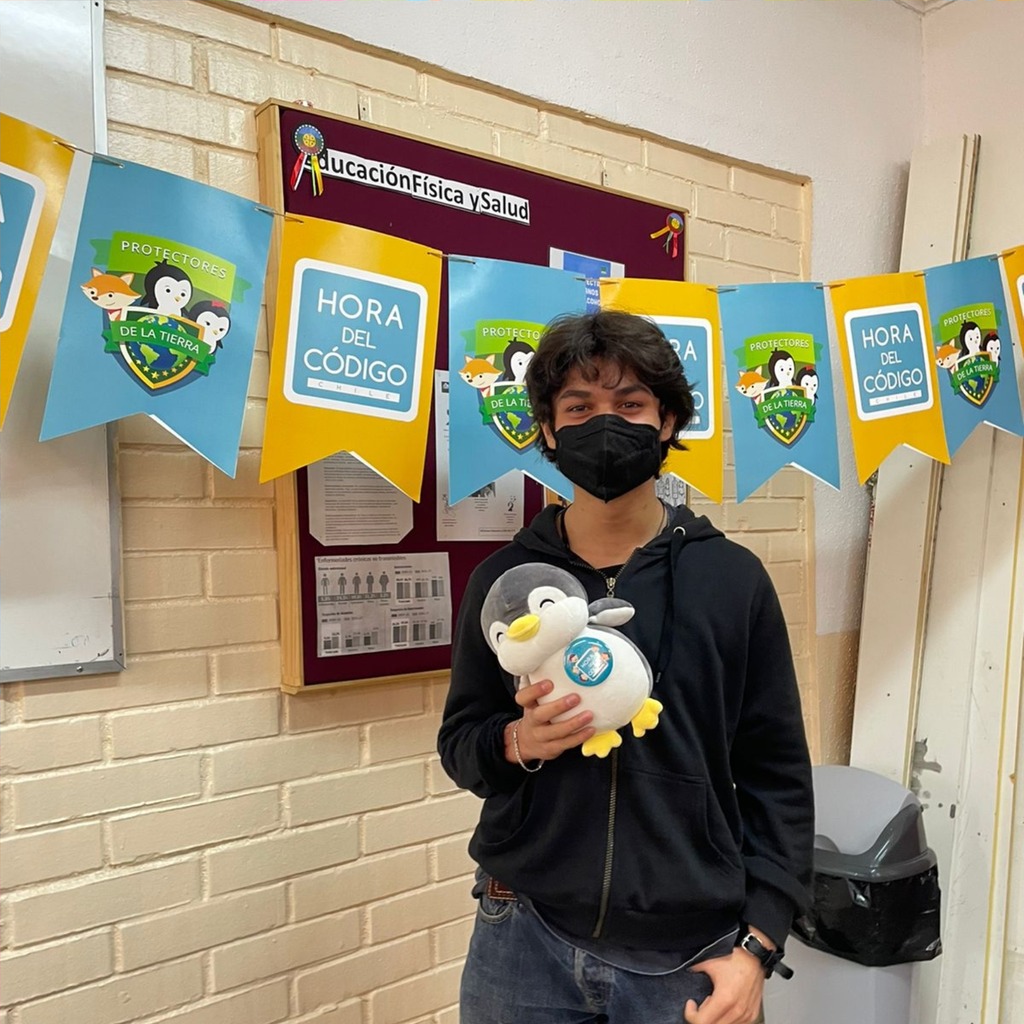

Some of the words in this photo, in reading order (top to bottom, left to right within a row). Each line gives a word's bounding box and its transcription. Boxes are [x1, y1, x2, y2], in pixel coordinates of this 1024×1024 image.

[121, 240, 228, 280] PROTECTORES
[317, 287, 404, 331] HORA
[942, 307, 993, 328] PROTECTORES
[119, 325, 138, 337] DE
[141, 327, 156, 339] LA
[159, 330, 201, 355] TIERRA
[341, 326, 377, 350] DEL
[482, 327, 541, 340] PROTECTO
[861, 323, 914, 349] HORA
[668, 338, 698, 362] RA
[749, 338, 810, 352] PROTECTORES
[303, 345, 408, 387] CÓDIGO
[880, 350, 903, 366] DEL
[863, 367, 924, 394] CÓDIGO
[956, 372, 966, 381] DE
[966, 367, 975, 377] LA
[974, 363, 994, 375] TIERRA
[318, 380, 391, 400] CHILE
[490, 399, 504, 409] DE
[505, 398, 517, 407] LA
[518, 397, 532, 408] TIE
[762, 404, 773, 413] DE
[774, 401, 783, 409] LA
[783, 399, 807, 409] TIERRA
